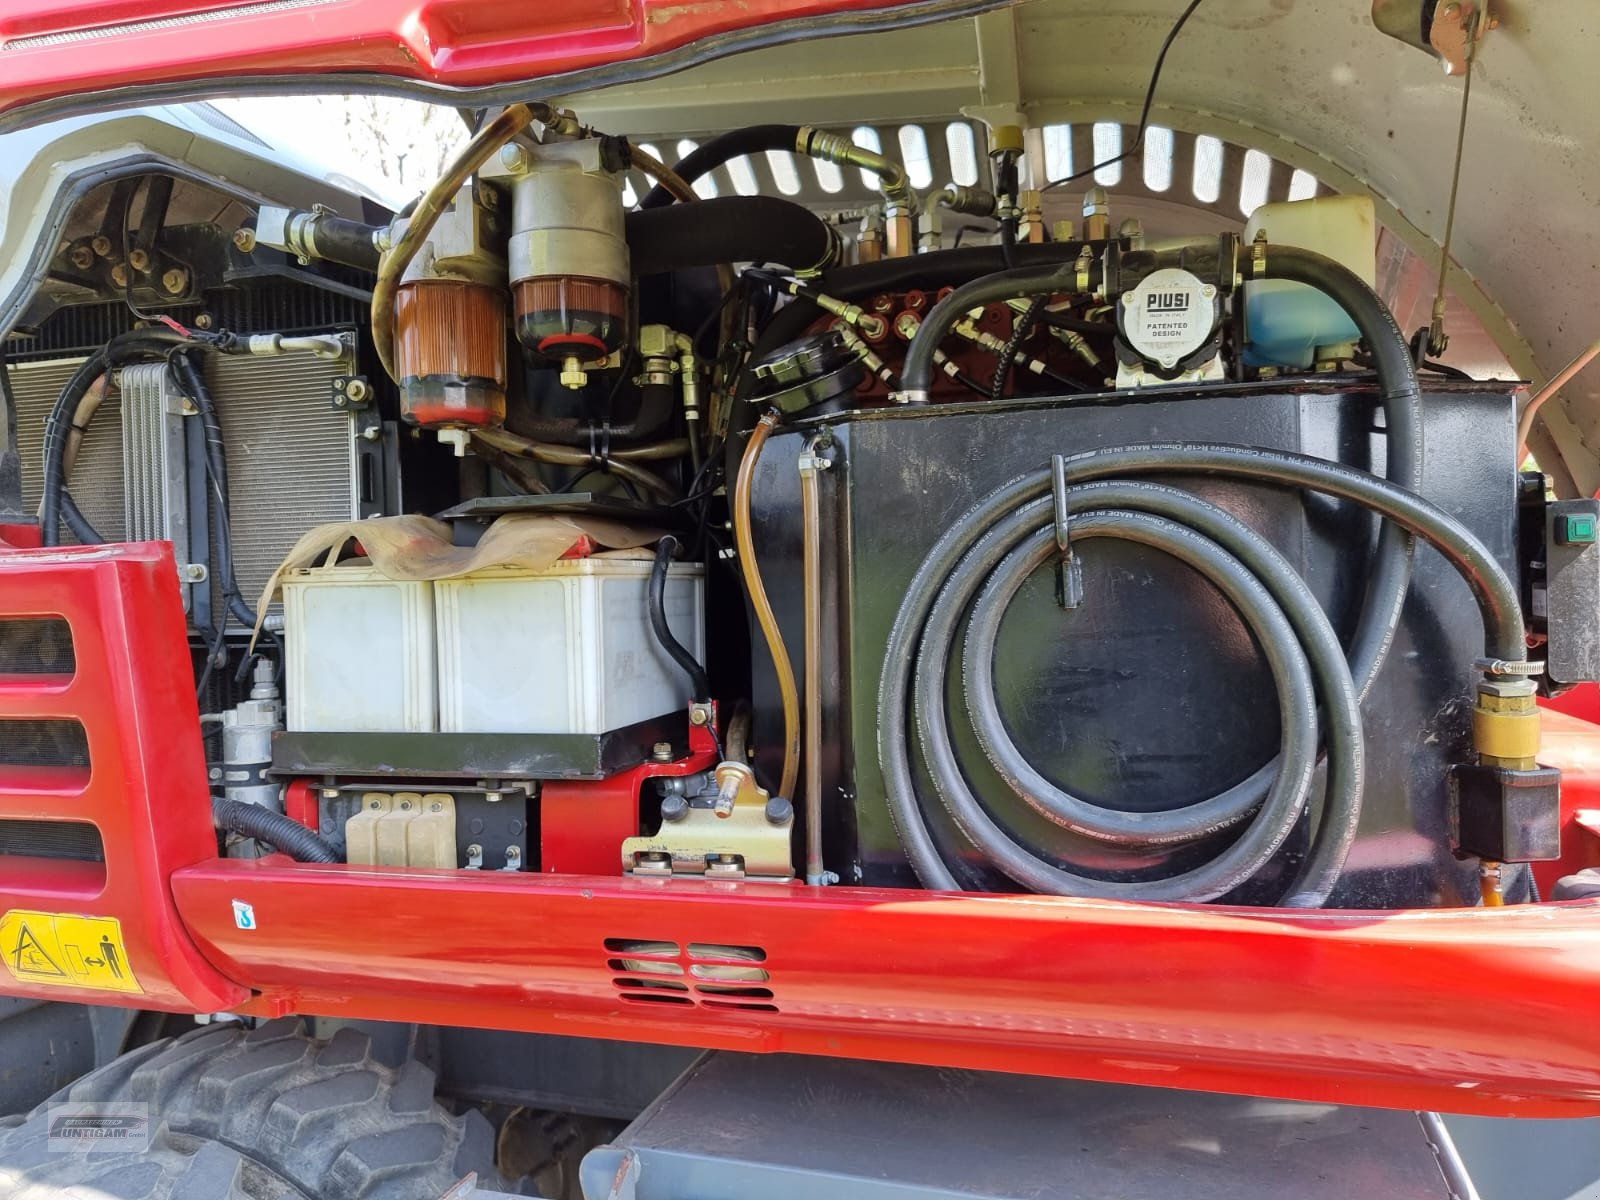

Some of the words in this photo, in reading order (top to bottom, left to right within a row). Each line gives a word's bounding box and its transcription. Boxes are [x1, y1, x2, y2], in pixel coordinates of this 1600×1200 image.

[1147, 293, 1190, 308] PIUSI
[1396, 334, 1414, 378] Conductive
[1412, 406, 1420, 418] PN
[1210, 445, 1260, 457] Conductive
[1287, 456, 1301, 465] PN
[1082, 481, 1108, 489] MADE
[1414, 477, 1420, 486] 10
[1166, 488, 1213, 510] Conductive
[1134, 513, 1164, 526] Ohm/m
[1188, 532, 1232, 563] Conductive
[1382, 631, 1392, 644] EU
[1379, 644, 1387, 654] IN
[1368, 653, 1383, 679] MADE
[1206, 824, 1218, 833] TU
[1262, 832, 1284, 856] MADE
[1279, 822, 1289, 834] IN
